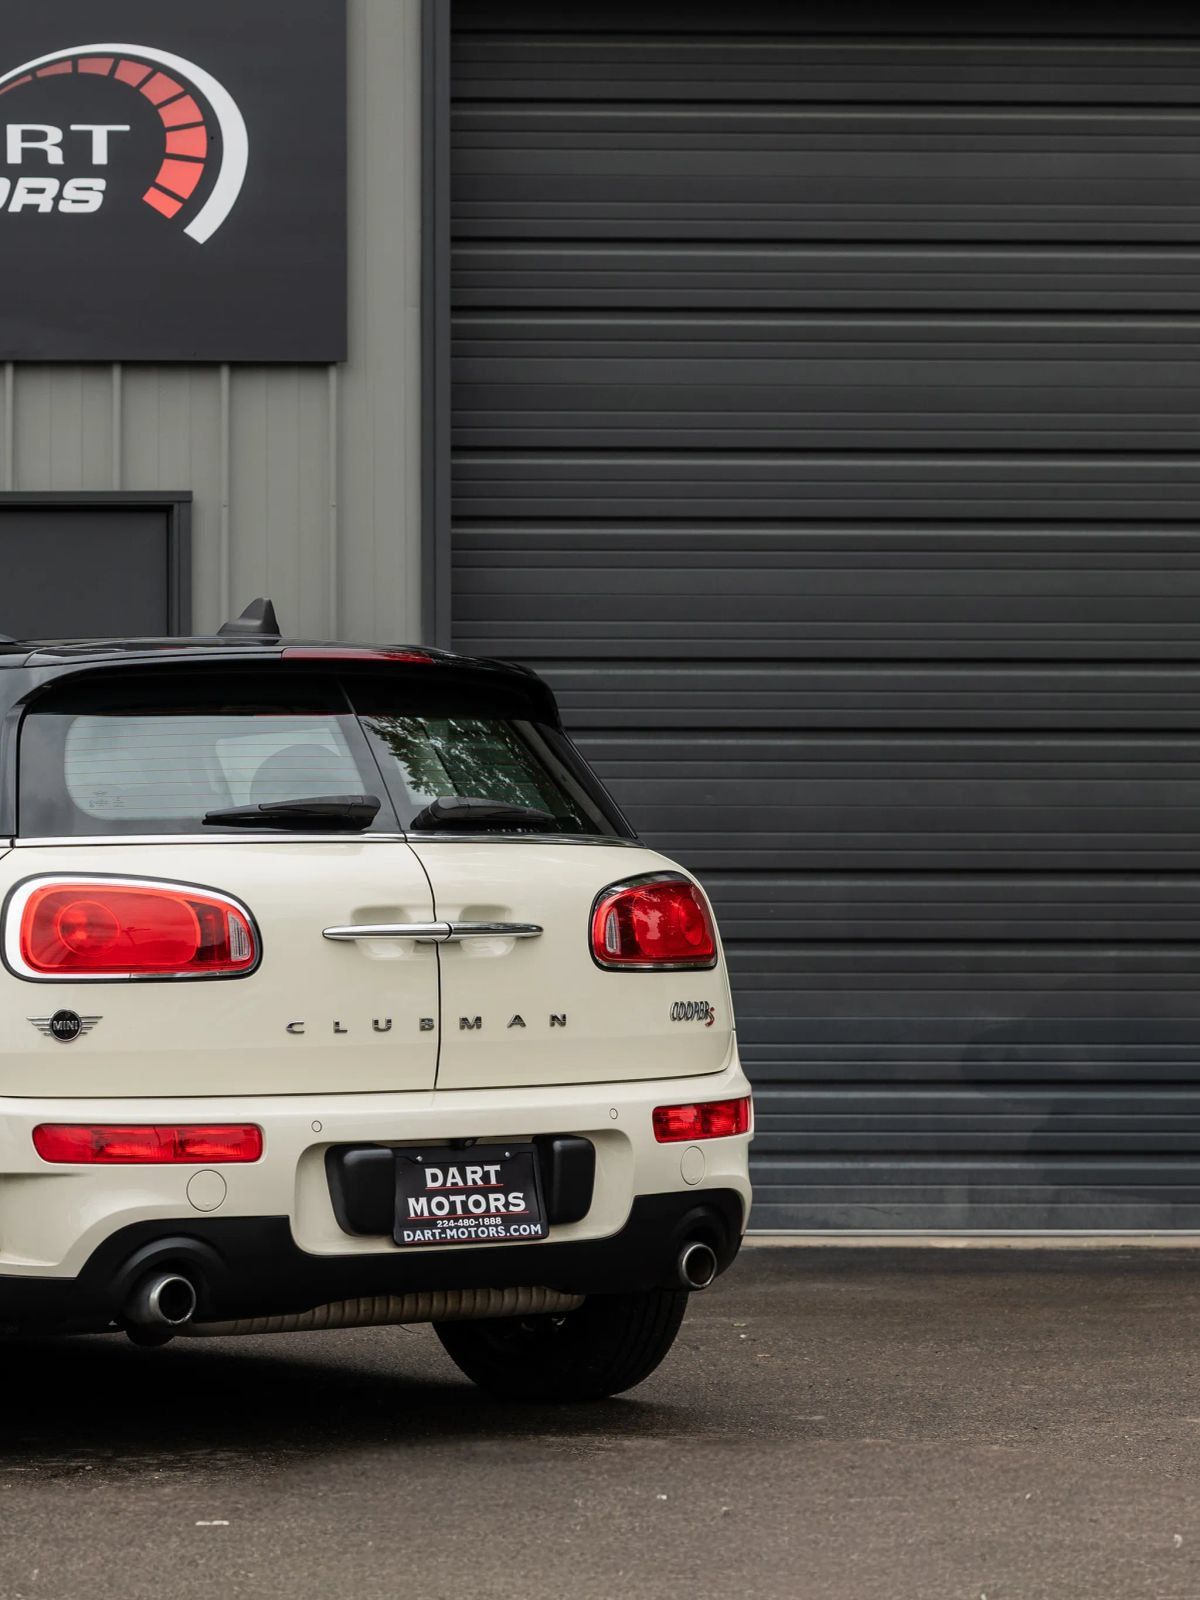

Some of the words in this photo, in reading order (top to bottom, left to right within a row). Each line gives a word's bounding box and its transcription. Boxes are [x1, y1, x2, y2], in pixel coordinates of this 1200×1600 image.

[52, 1020, 79, 1031] MINI
[286, 1013, 567, 1035] CLUBMAN
[424, 1164, 501, 1188] DART
[407, 1192, 526, 1218] MOTORS
[436, 1217, 502, 1228] 224-480-1888
[403, 1224, 542, 1242] DART-MOTORS.COM
